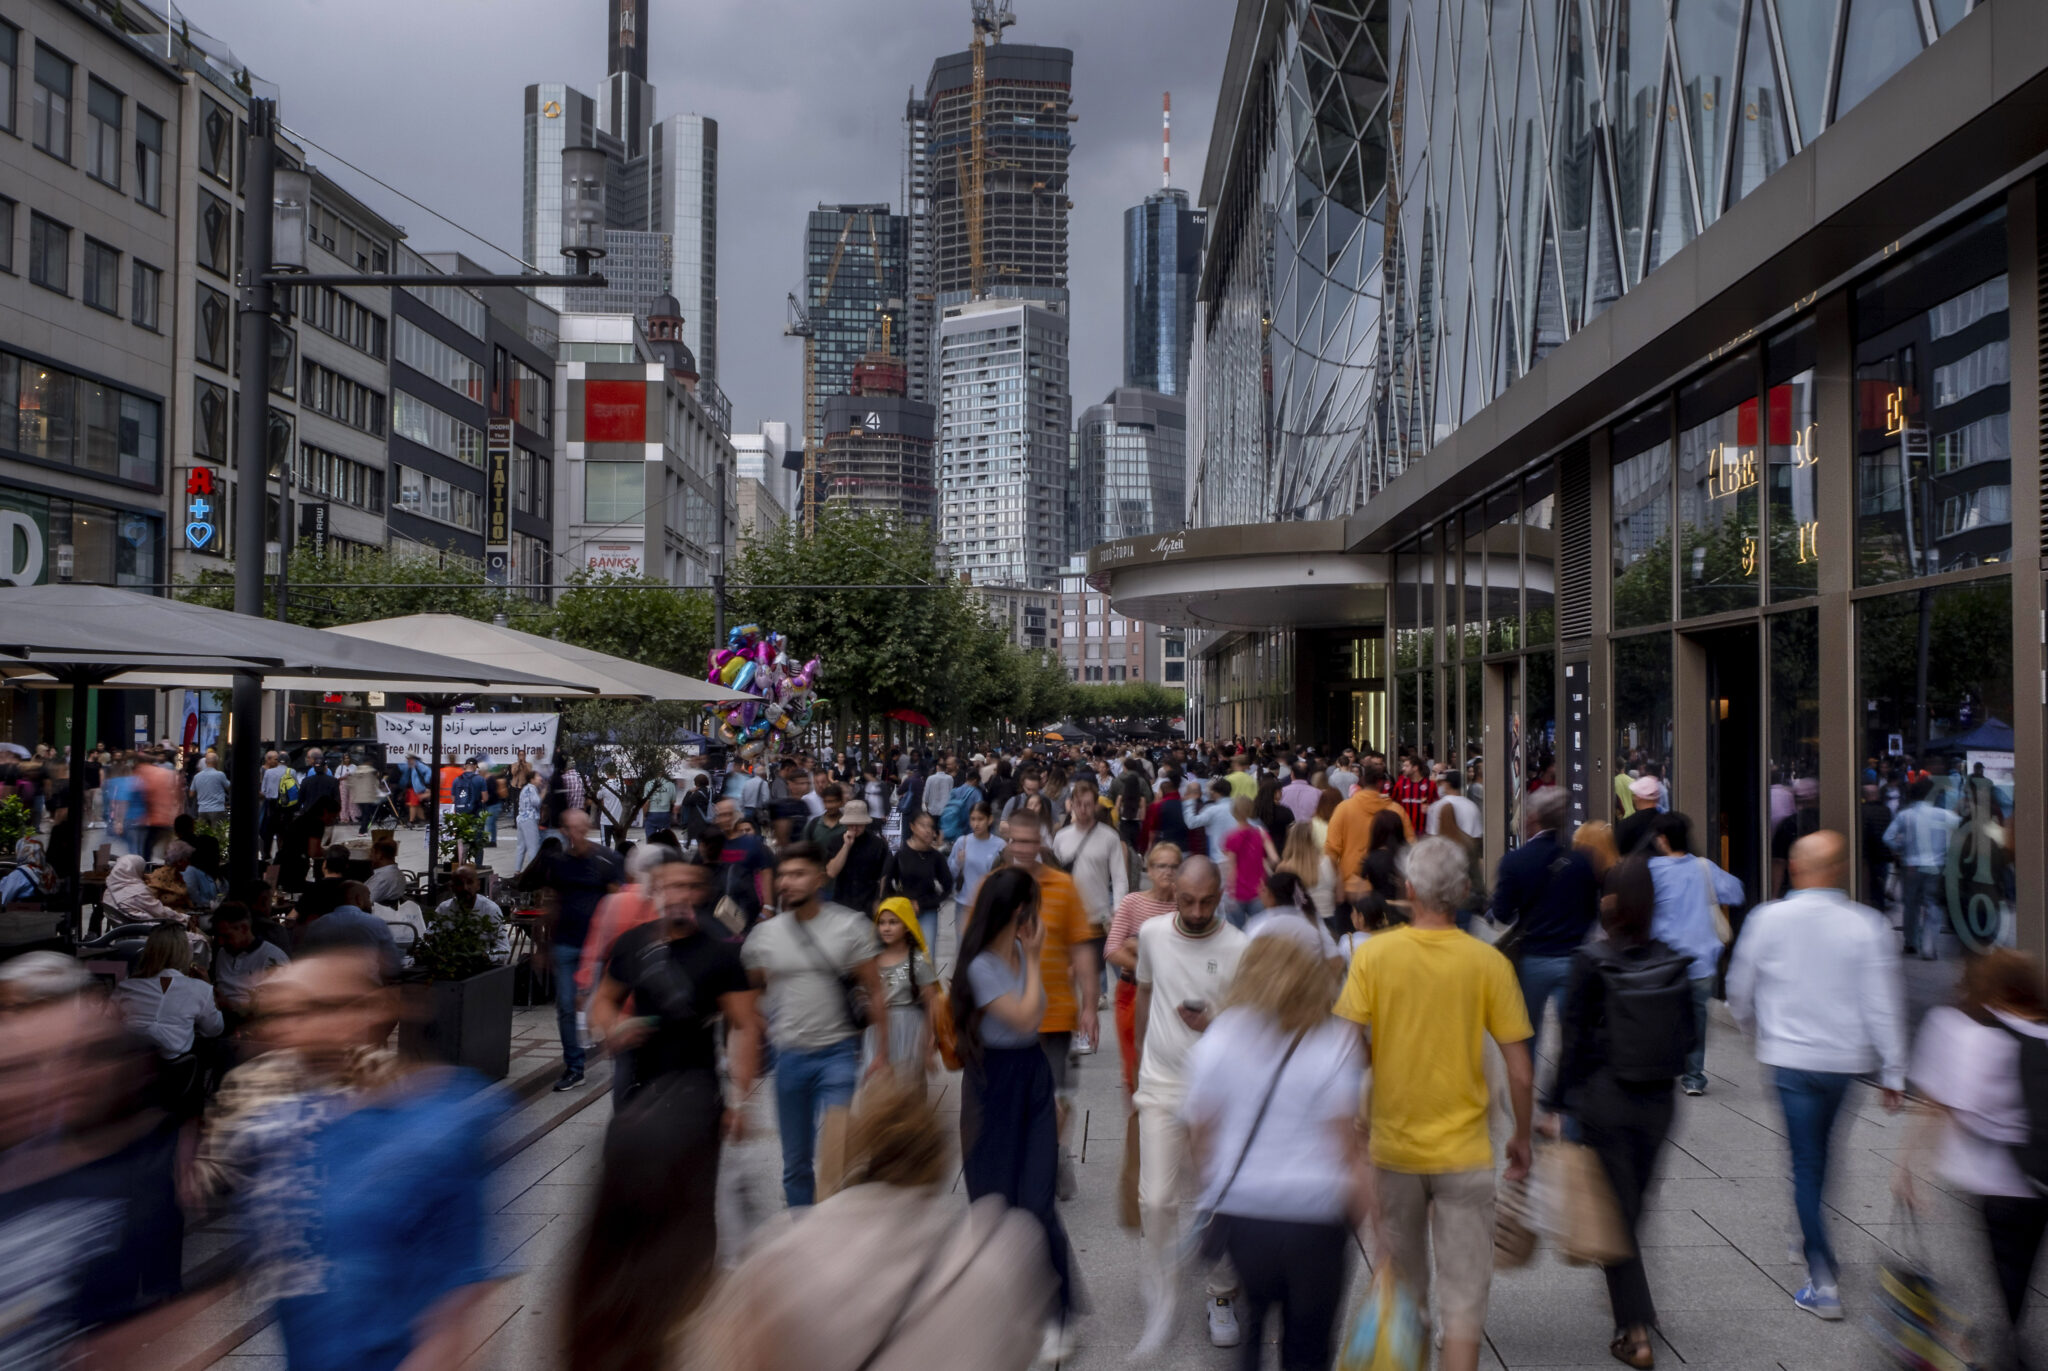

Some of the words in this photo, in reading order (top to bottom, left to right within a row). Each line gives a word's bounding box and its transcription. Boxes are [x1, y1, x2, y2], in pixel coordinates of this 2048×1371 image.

[493, 455, 506, 539] TATTOO
[316, 507, 324, 531] RAW
[1151, 533, 1184, 560] MyZeil
[589, 557, 640, 569] BANKSY
[469, 721, 507, 736] سیاسی
[511, 719, 547, 736] زندانی
[386, 743, 405, 755] Free
[408, 743, 420, 755] All
[422, 743, 461, 755] Potical
[463, 743, 508, 755] Prisoners
[511, 743, 521, 755] in
